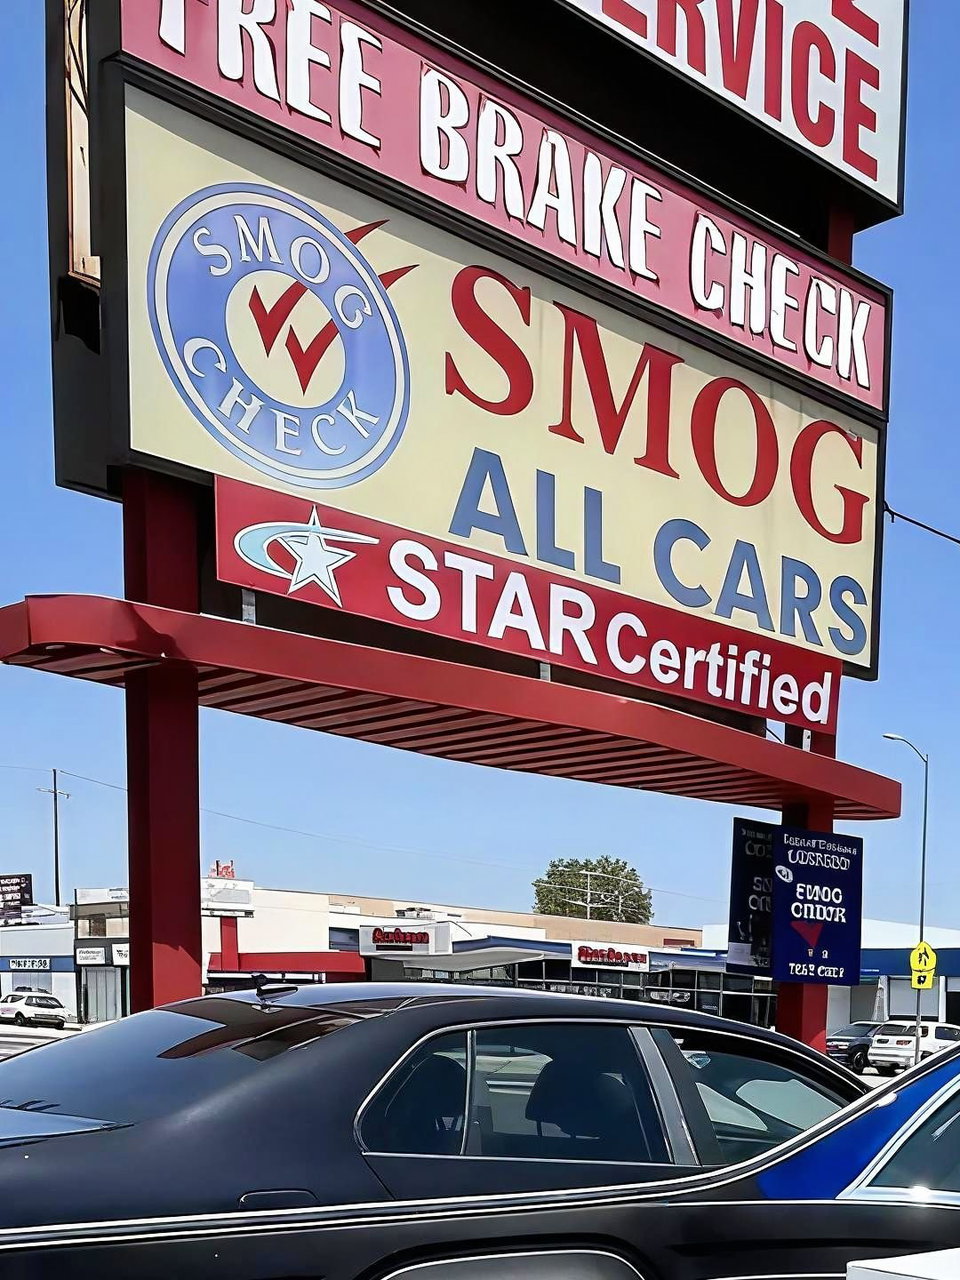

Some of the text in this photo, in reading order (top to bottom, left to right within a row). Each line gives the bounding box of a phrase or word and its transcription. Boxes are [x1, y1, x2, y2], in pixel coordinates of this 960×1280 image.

[192, 214, 373, 330] SMOG
[418, 62, 663, 283] BRAKE
[690, 211, 872, 391] CHECK
[182, 337, 381, 457] CHECK
[444, 264, 870, 545] SMOG
[385, 538, 833, 726] STAR Certified
[447, 446, 868, 656] ALL CARS
